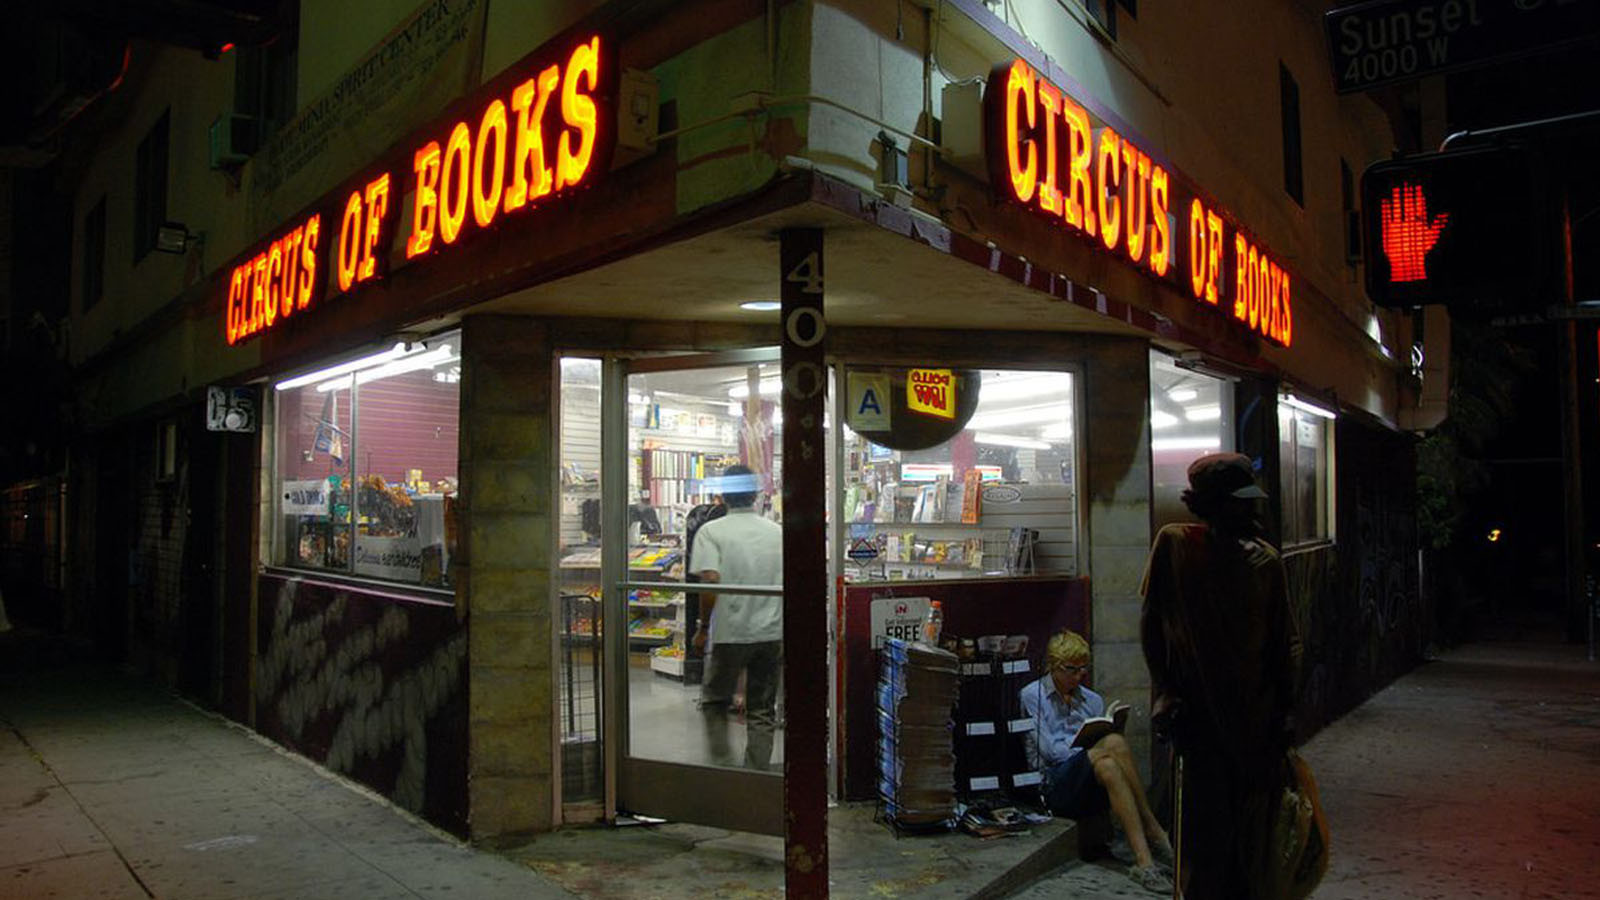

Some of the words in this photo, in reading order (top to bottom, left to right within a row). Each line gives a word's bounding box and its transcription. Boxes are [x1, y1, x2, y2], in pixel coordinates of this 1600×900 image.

[1339, 0, 1482, 56] Sunset
[1344, 45, 1417, 84] 4000
[1427, 36, 1449, 66] W
[227, 213, 320, 345] CIRCUS
[338, 173, 391, 291] OF
[406, 36, 600, 260] BOOKS
[1006, 58, 1170, 277] CIRCUS
[1190, 198, 1224, 305] OF
[1234, 231, 1292, 347] BOOKS
[858, 389, 881, 415] A
[886, 624, 920, 642] FREE
